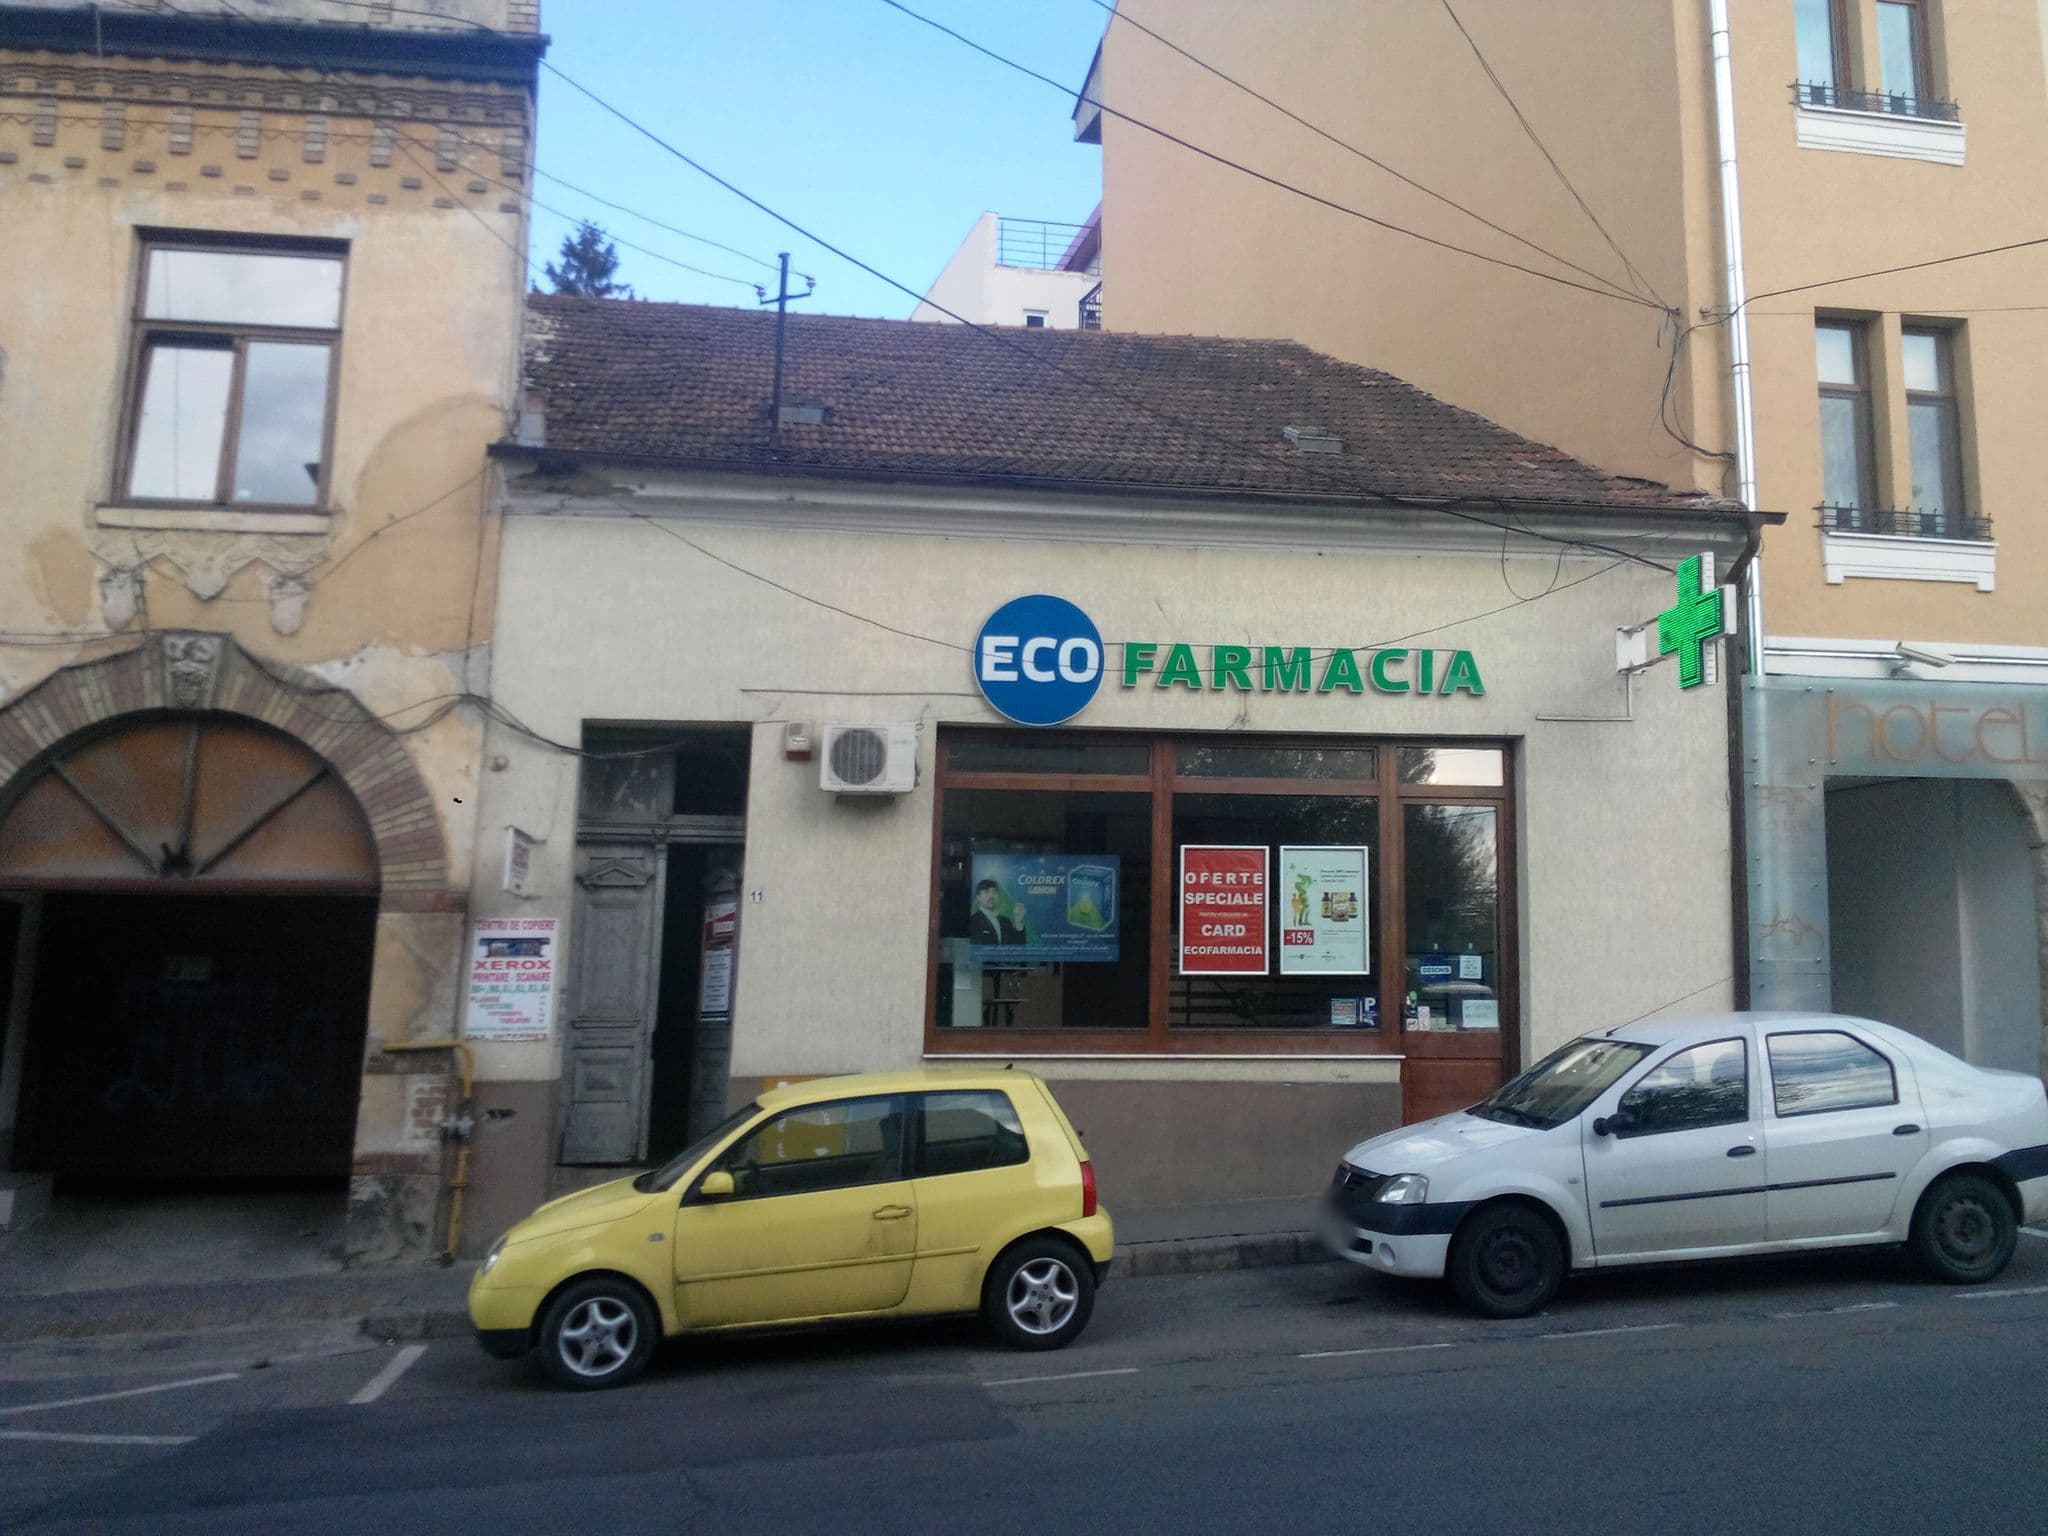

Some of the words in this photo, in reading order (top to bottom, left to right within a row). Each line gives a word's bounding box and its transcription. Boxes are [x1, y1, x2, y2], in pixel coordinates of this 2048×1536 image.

[981, 636, 1099, 684] ECO
[1121, 641, 1487, 697] FARMACIA
[1018, 873, 1067, 886] COLDREX
[1185, 872, 1263, 885] OFERTE
[751, 890, 763, 902] 11
[1185, 892, 1263, 905] SPECIALE
[1201, 924, 1246, 937] CARD
[1286, 932, 1313, 944] -15%
[1184, 945, 1263, 956] ECOFARMACIA
[475, 960, 551, 970] XEROX
